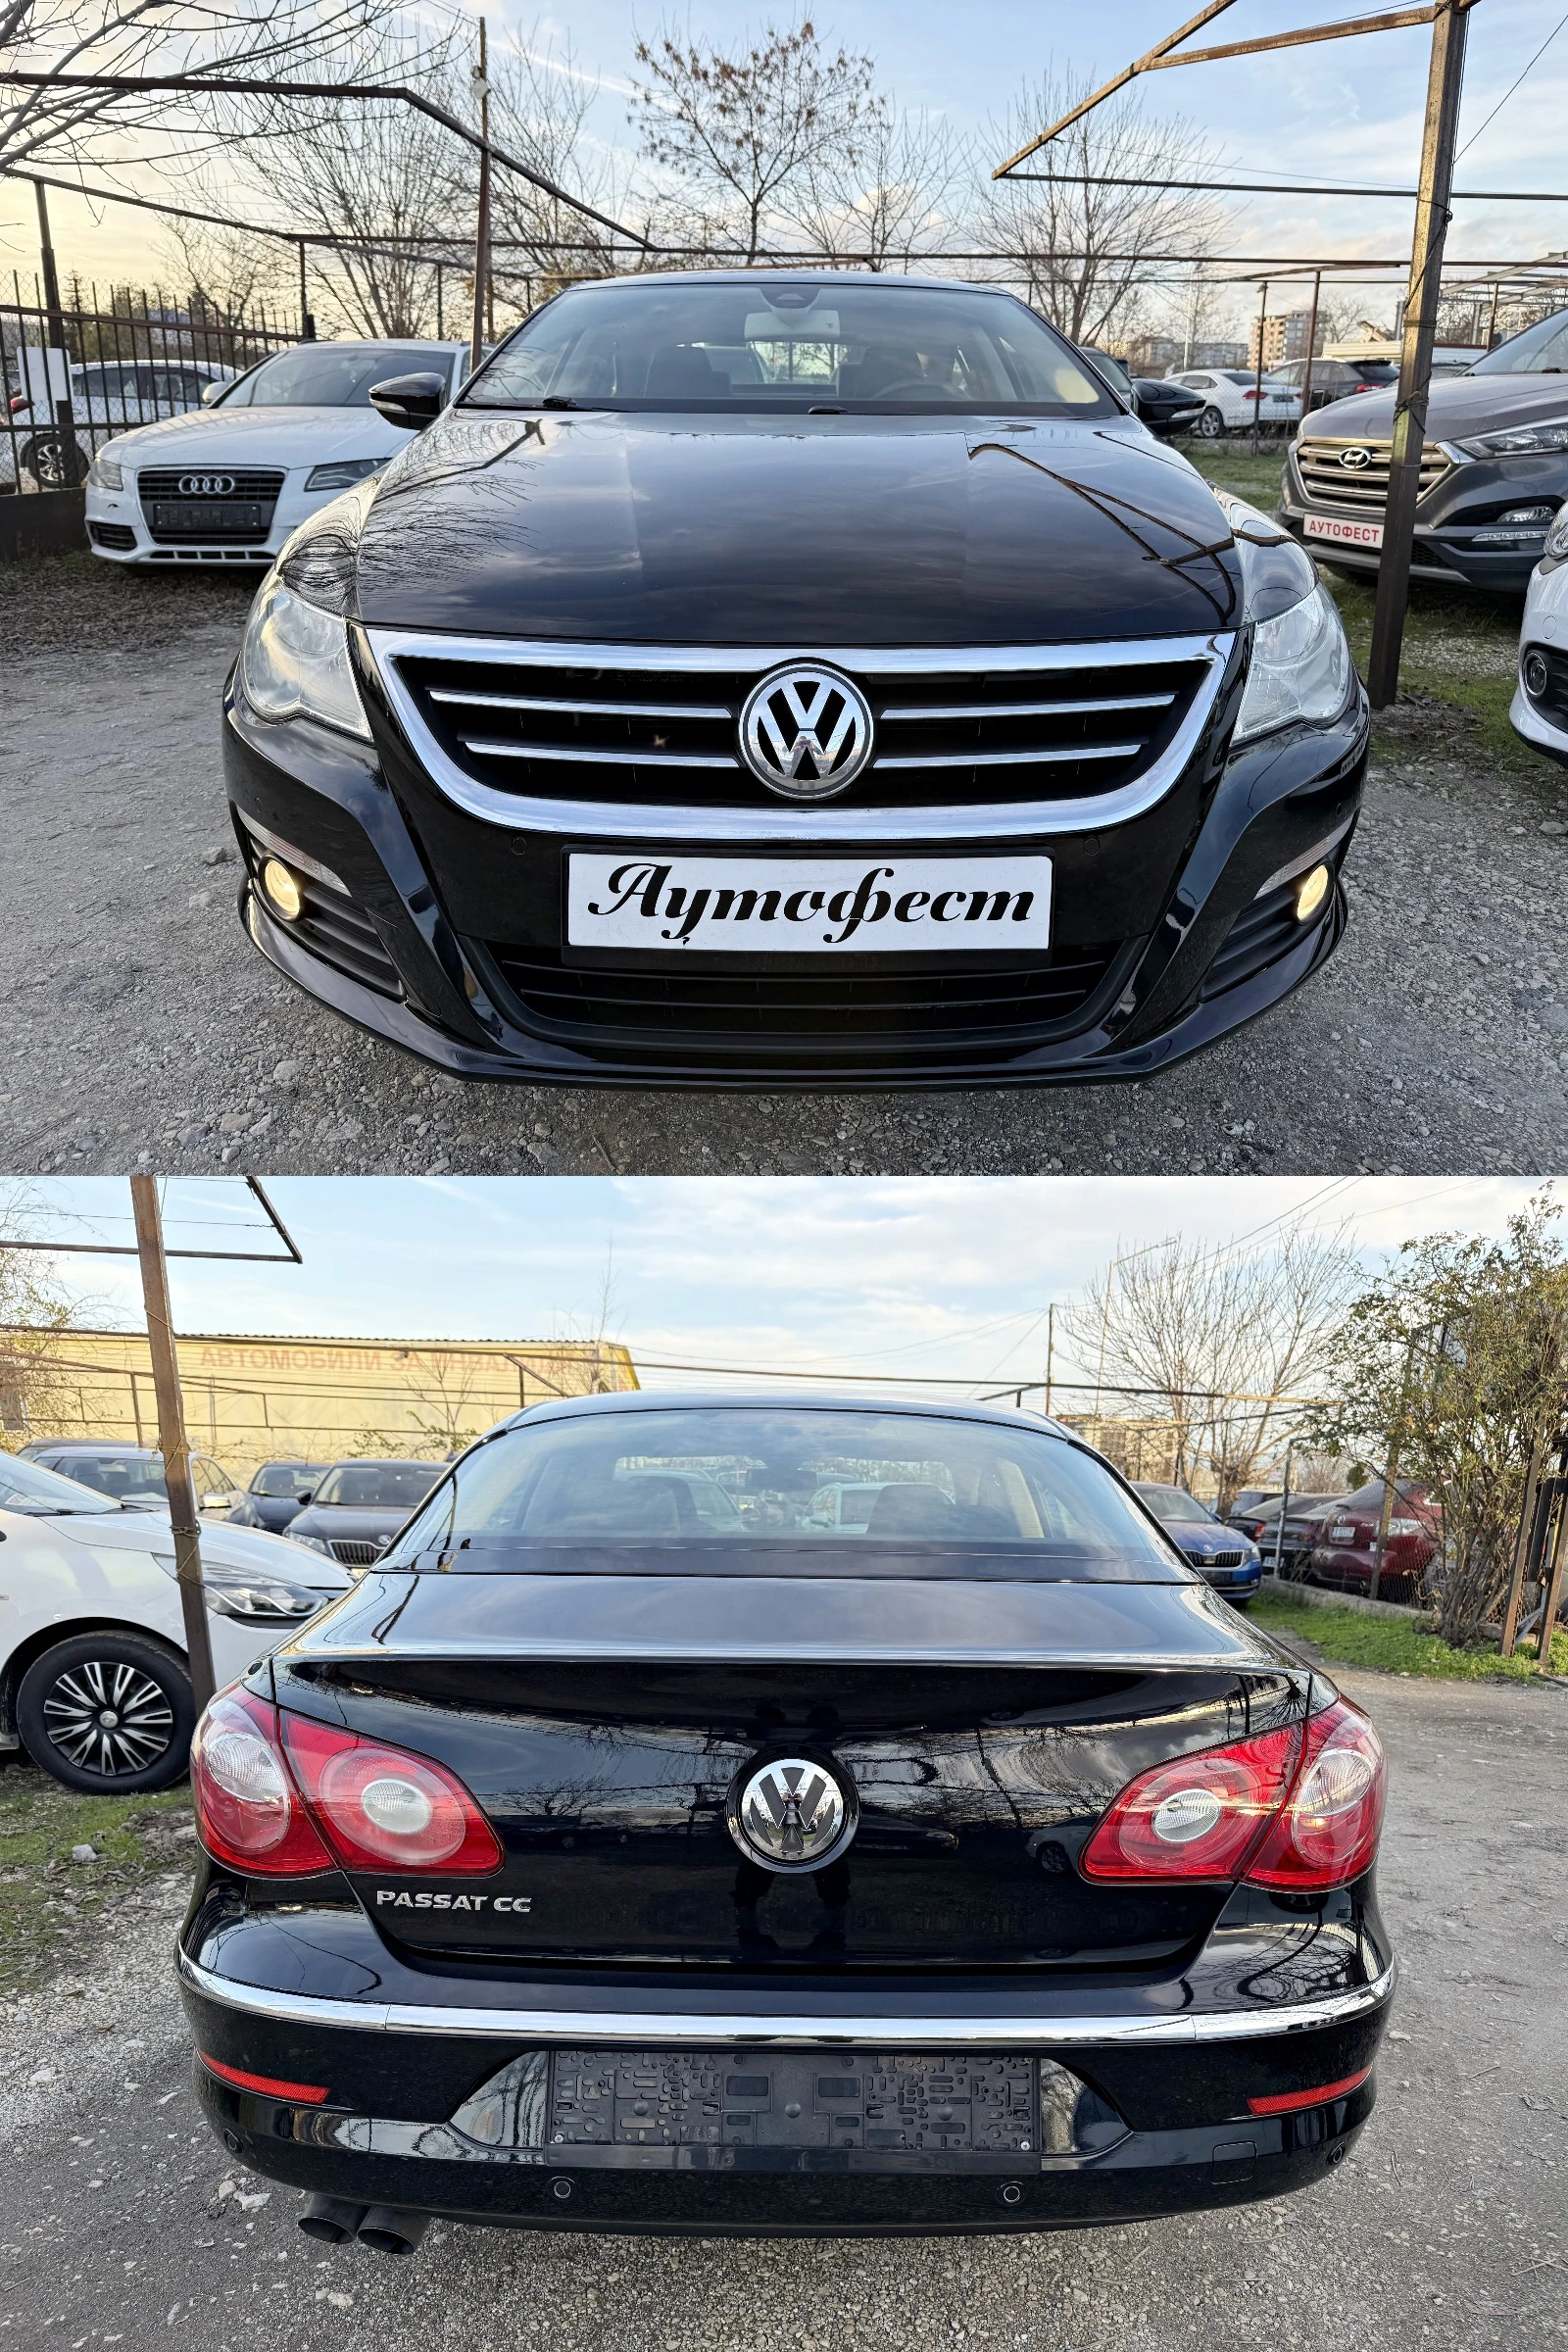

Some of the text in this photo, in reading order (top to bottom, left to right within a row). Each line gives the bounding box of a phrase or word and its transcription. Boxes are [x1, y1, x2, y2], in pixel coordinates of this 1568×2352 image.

[1309, 520, 1380, 542] АУТОФЕСТ
[587, 862, 1035, 945] Аутофест
[200, 1347, 381, 1370] АВТОМОБИЛИ
[376, 1890, 532, 1913] PASSAT CC
